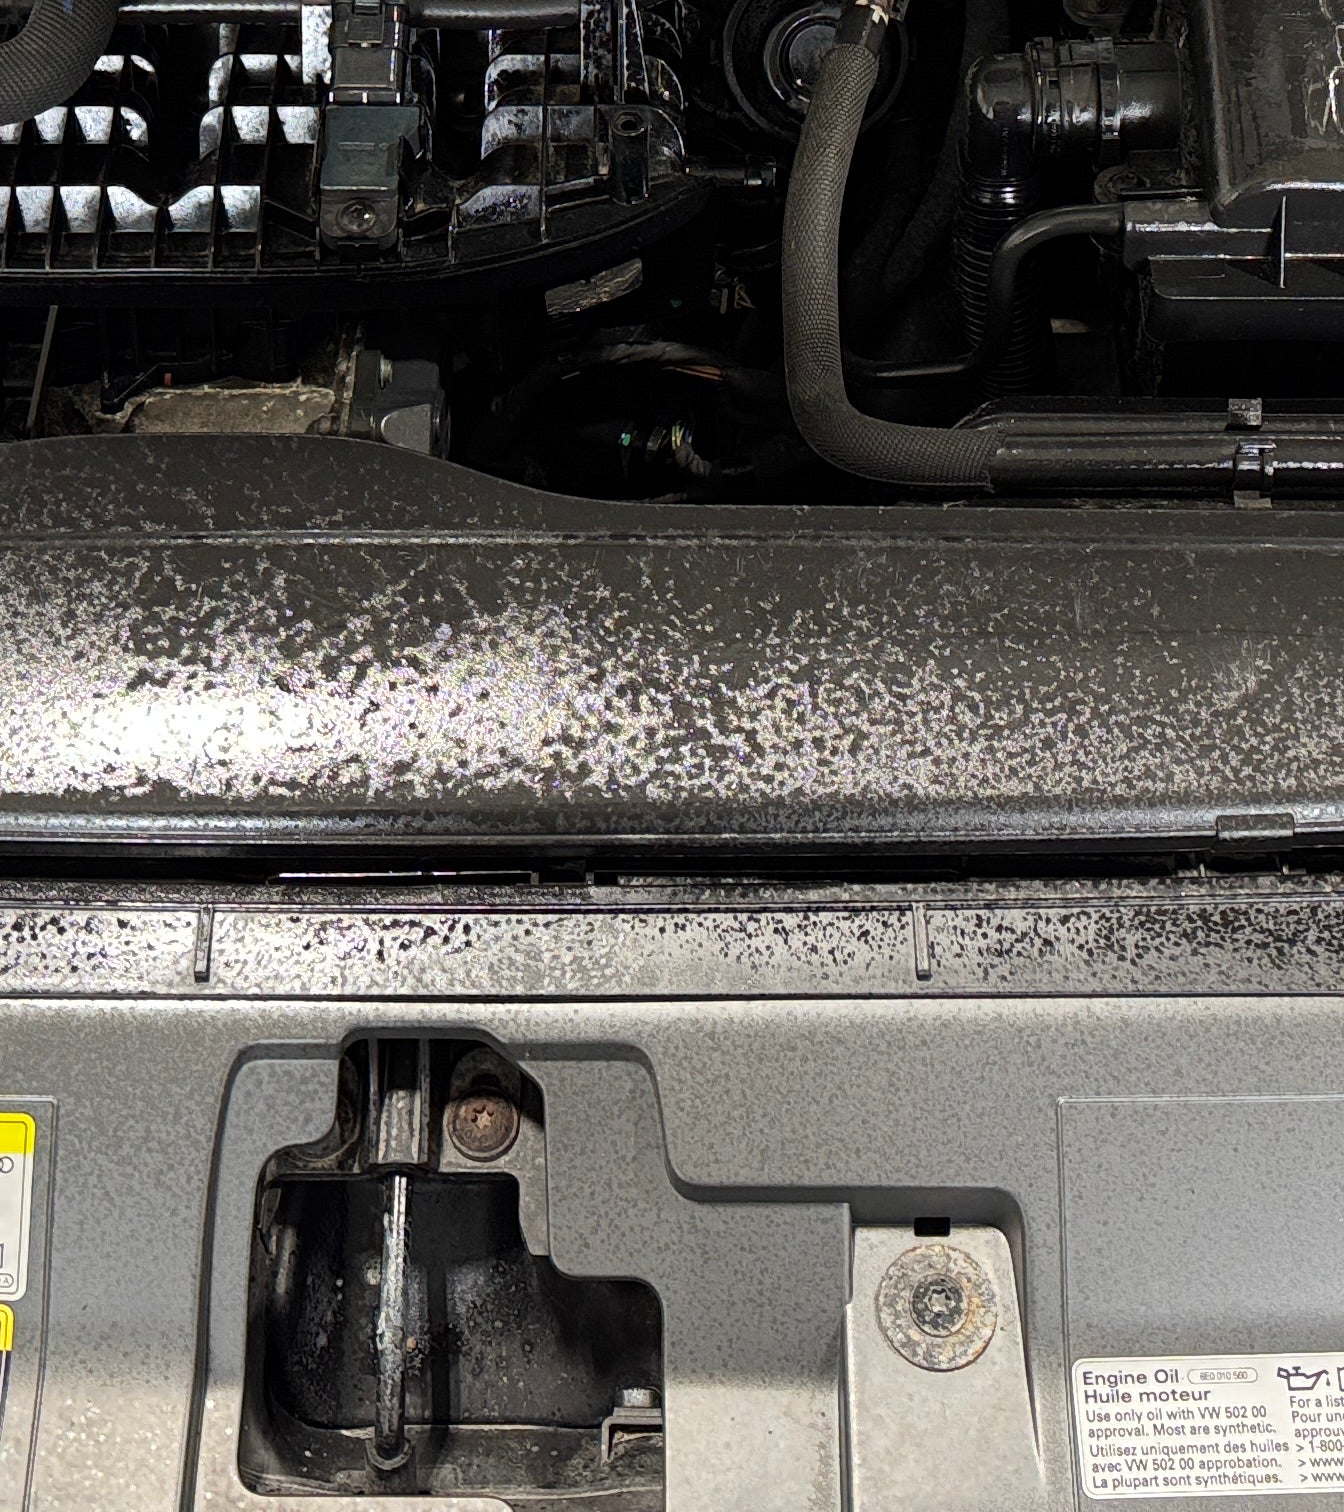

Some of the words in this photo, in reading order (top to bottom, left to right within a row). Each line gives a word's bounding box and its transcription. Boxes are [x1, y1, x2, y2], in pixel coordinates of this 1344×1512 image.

[1083, 1370, 1148, 1388] Engine
[1154, 1368, 1180, 1384] Oil
[1084, 1389, 1132, 1404] Huile
[1139, 1388, 1211, 1403] moteur
[1289, 1395, 1311, 1408] For
[1315, 1398, 1323, 1408] a
[1086, 1409, 1111, 1423] Use
[1115, 1409, 1142, 1424] only
[1147, 1407, 1162, 1421] oil
[1166, 1407, 1194, 1421] with
[1197, 1406, 1221, 1420] VW
[1225, 1405, 1248, 1419] 502
[1252, 1405, 1267, 1418] 00
[1291, 1410, 1322, 1423] Pour
[1088, 1424, 1149, 1440] approval.
[1153, 1423, 1186, 1437] Most
[1190, 1425, 1210, 1436] are
[1214, 1421, 1277, 1437] synthetic.
[1089, 1443, 1137, 1458] Utilisez
[1141, 1442, 1220, 1461] uniquement
[1224, 1440, 1247, 1454] des
[1250, 1439, 1290, 1453] huiles
[1092, 1462, 1122, 1473] avec
[1125, 1459, 1149, 1472] VW
[1152, 1458, 1176, 1471] 502
[1179, 1457, 1195, 1470] 00
[1199, 1456, 1282, 1472] approbation.
[1093, 1476, 1108, 1489] La
[1112, 1474, 1159, 1491] plupart
[1163, 1473, 1192, 1487] sont
[1195, 1472, 1283, 1489] synthétiques.
